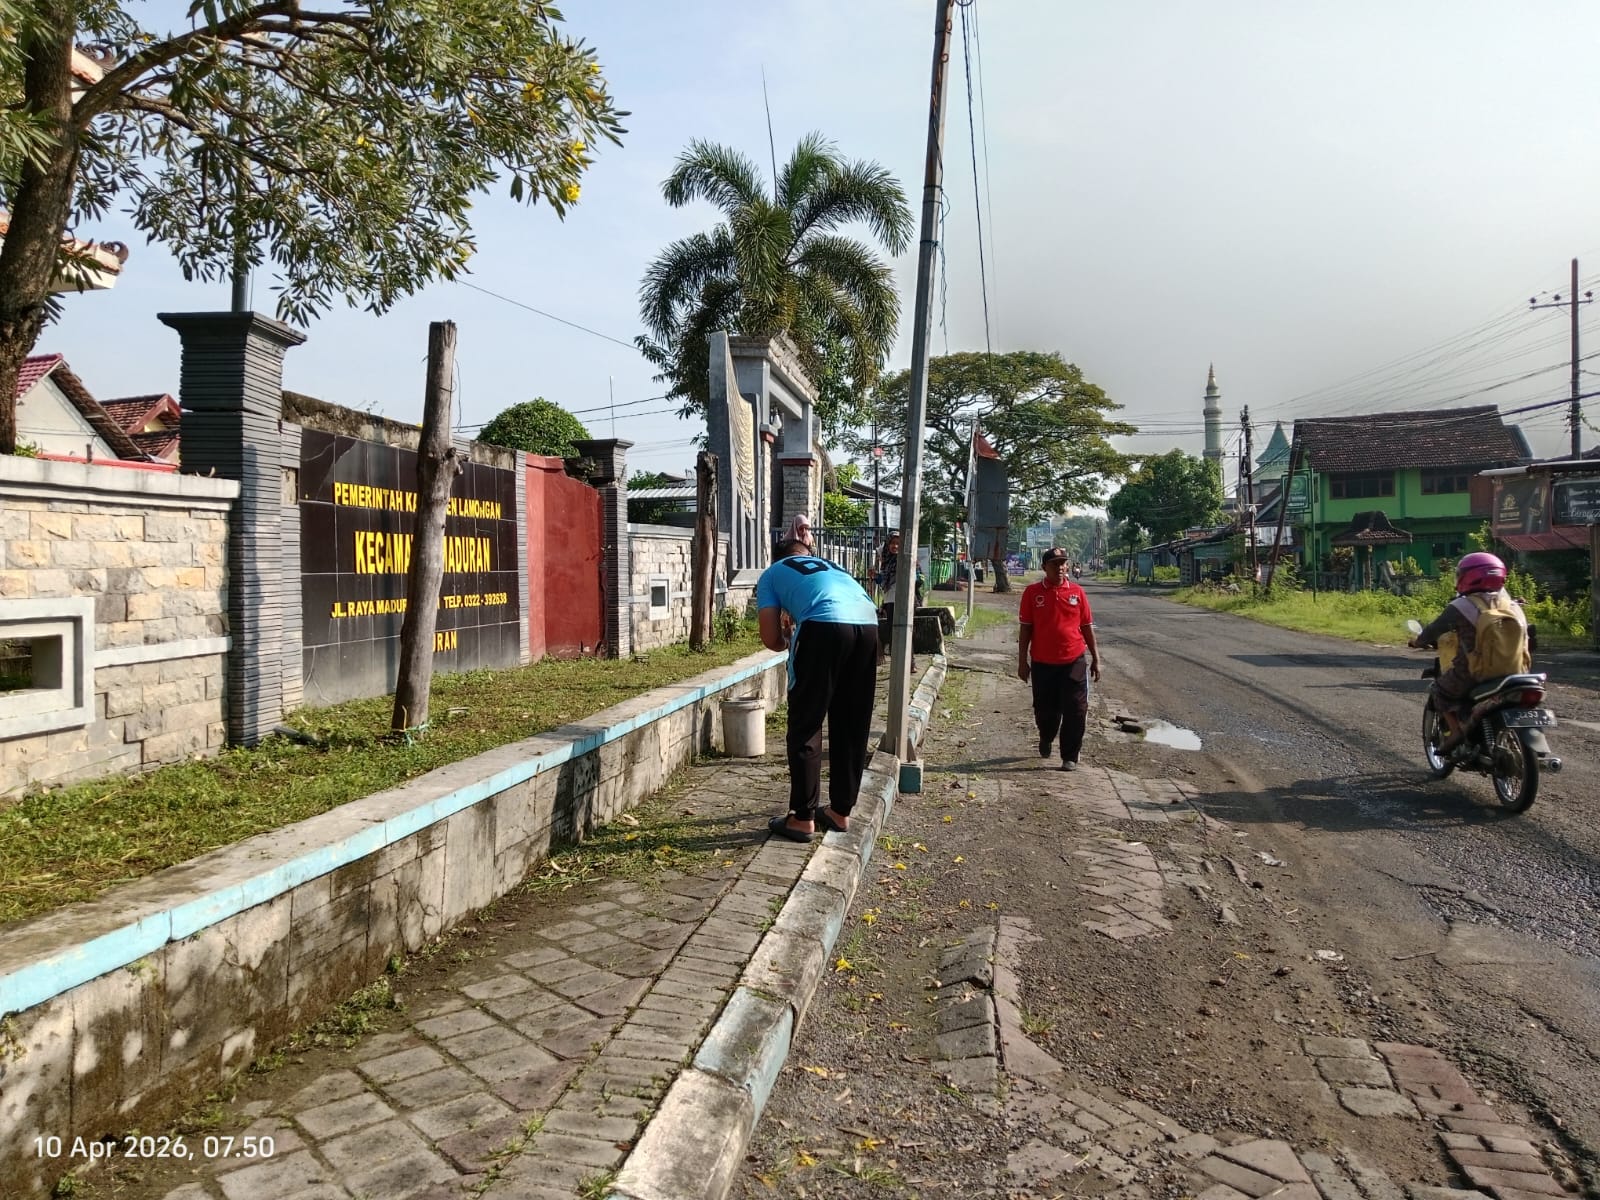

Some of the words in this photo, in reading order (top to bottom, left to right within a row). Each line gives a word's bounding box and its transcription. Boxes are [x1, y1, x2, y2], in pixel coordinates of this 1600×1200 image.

[334, 482, 403, 512] PEMERINTAH
[355, 531, 413, 574] KECAMA
[331, 602, 347, 618] JL.
[348, 600, 376, 616] RAYA
[376, 598, 407, 614] MADUR
[443, 595, 464, 609] TELP.
